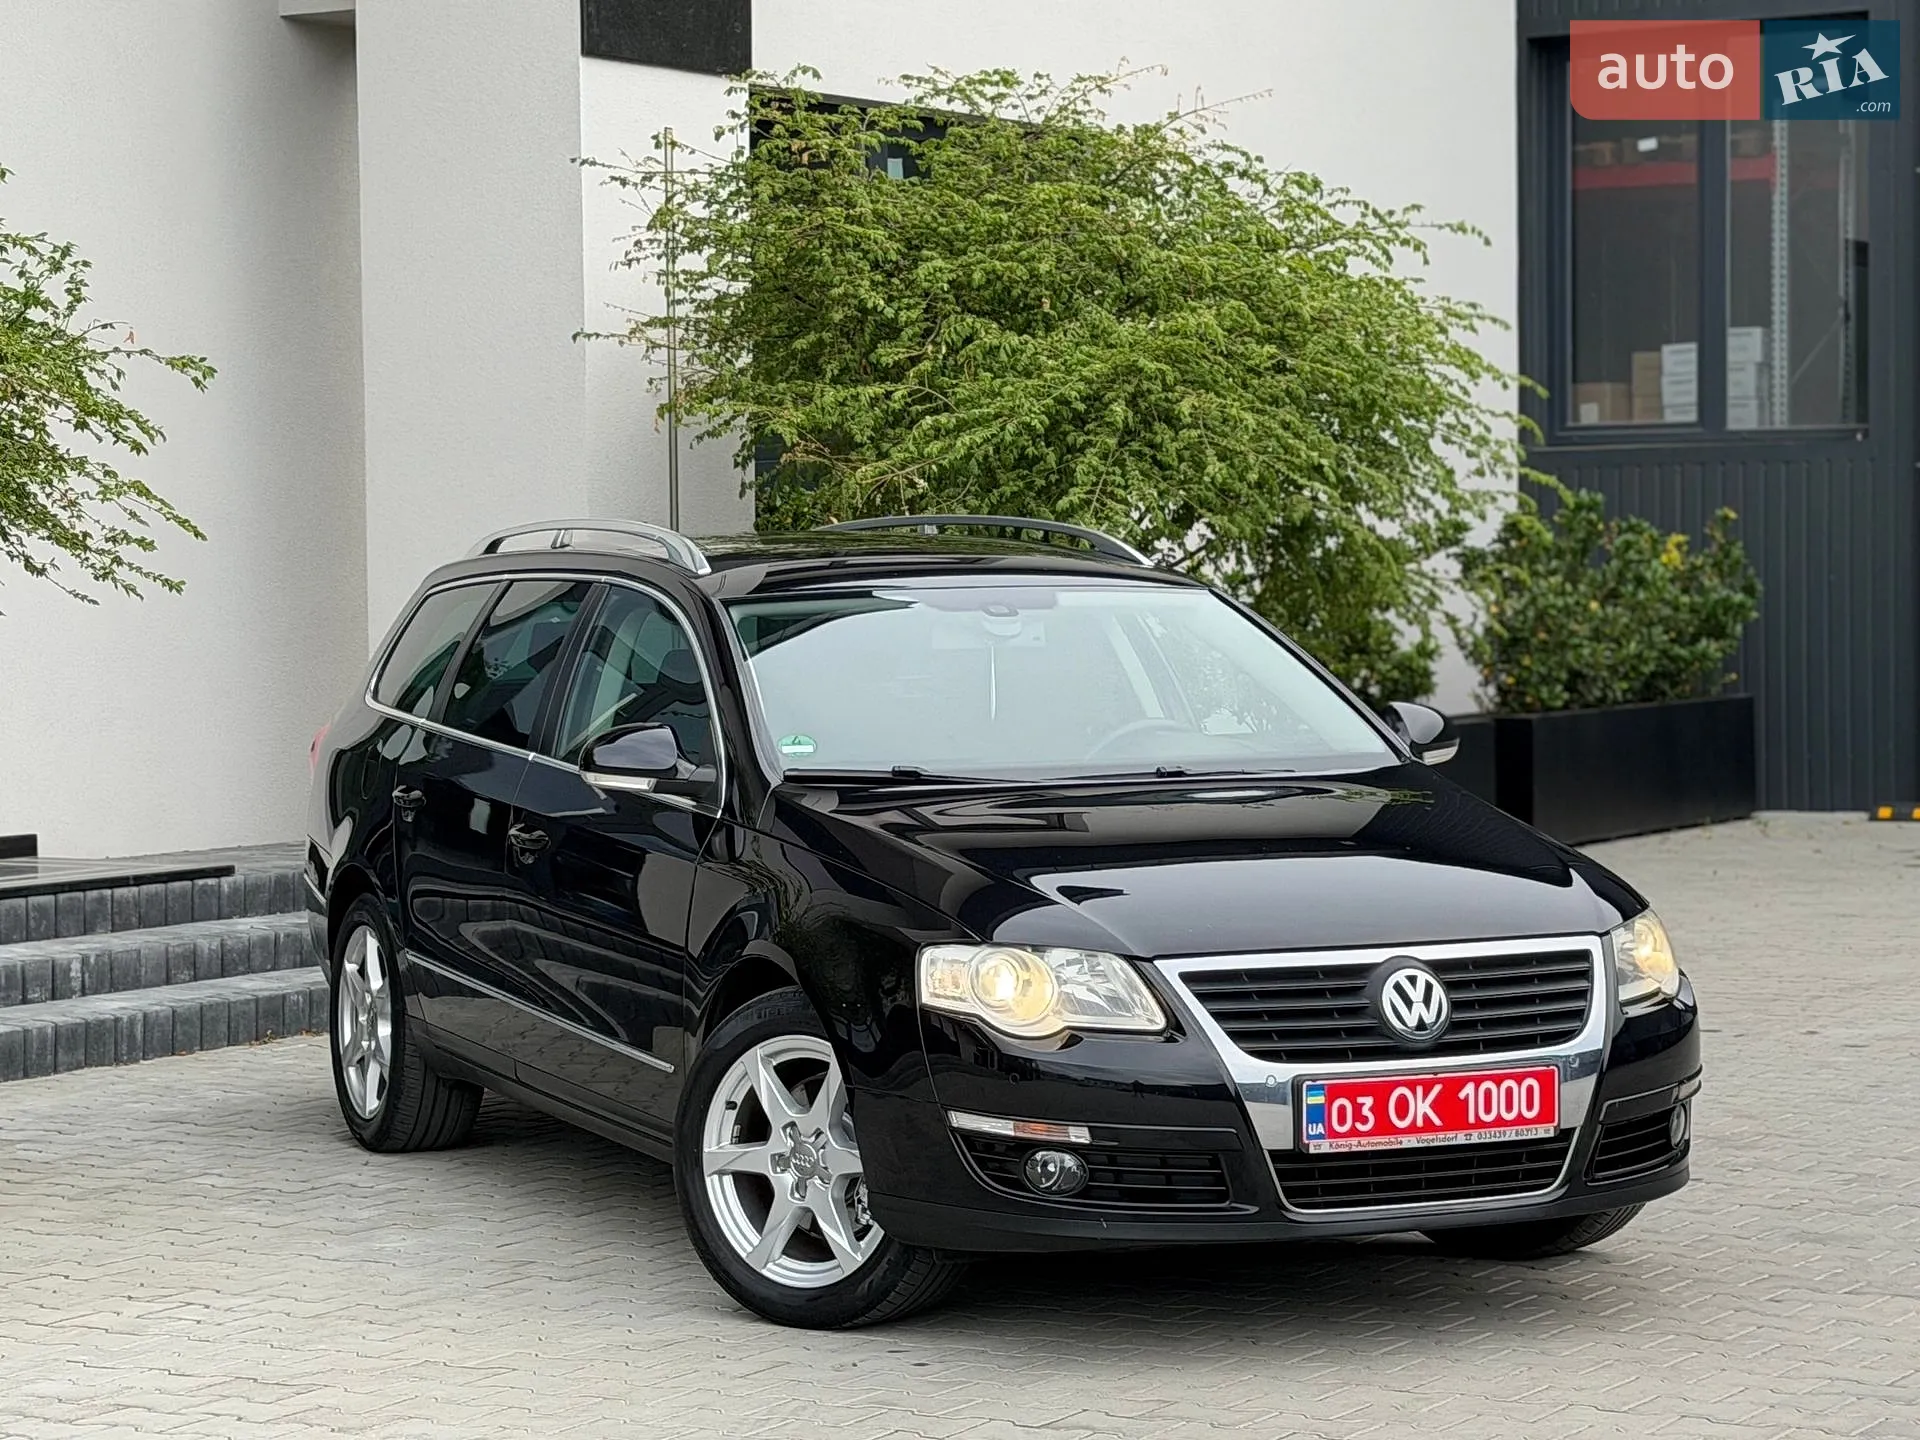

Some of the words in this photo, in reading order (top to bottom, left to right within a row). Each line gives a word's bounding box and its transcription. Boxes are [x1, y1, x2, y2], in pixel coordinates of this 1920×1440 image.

[1330, 1096, 1376, 1134] 03
[1387, 1083, 1444, 1129] OK
[1457, 1076, 1541, 1125] 1000
[1308, 1122, 1326, 1136] UA
[1415, 1133, 1458, 1145] Vogelsdorf
